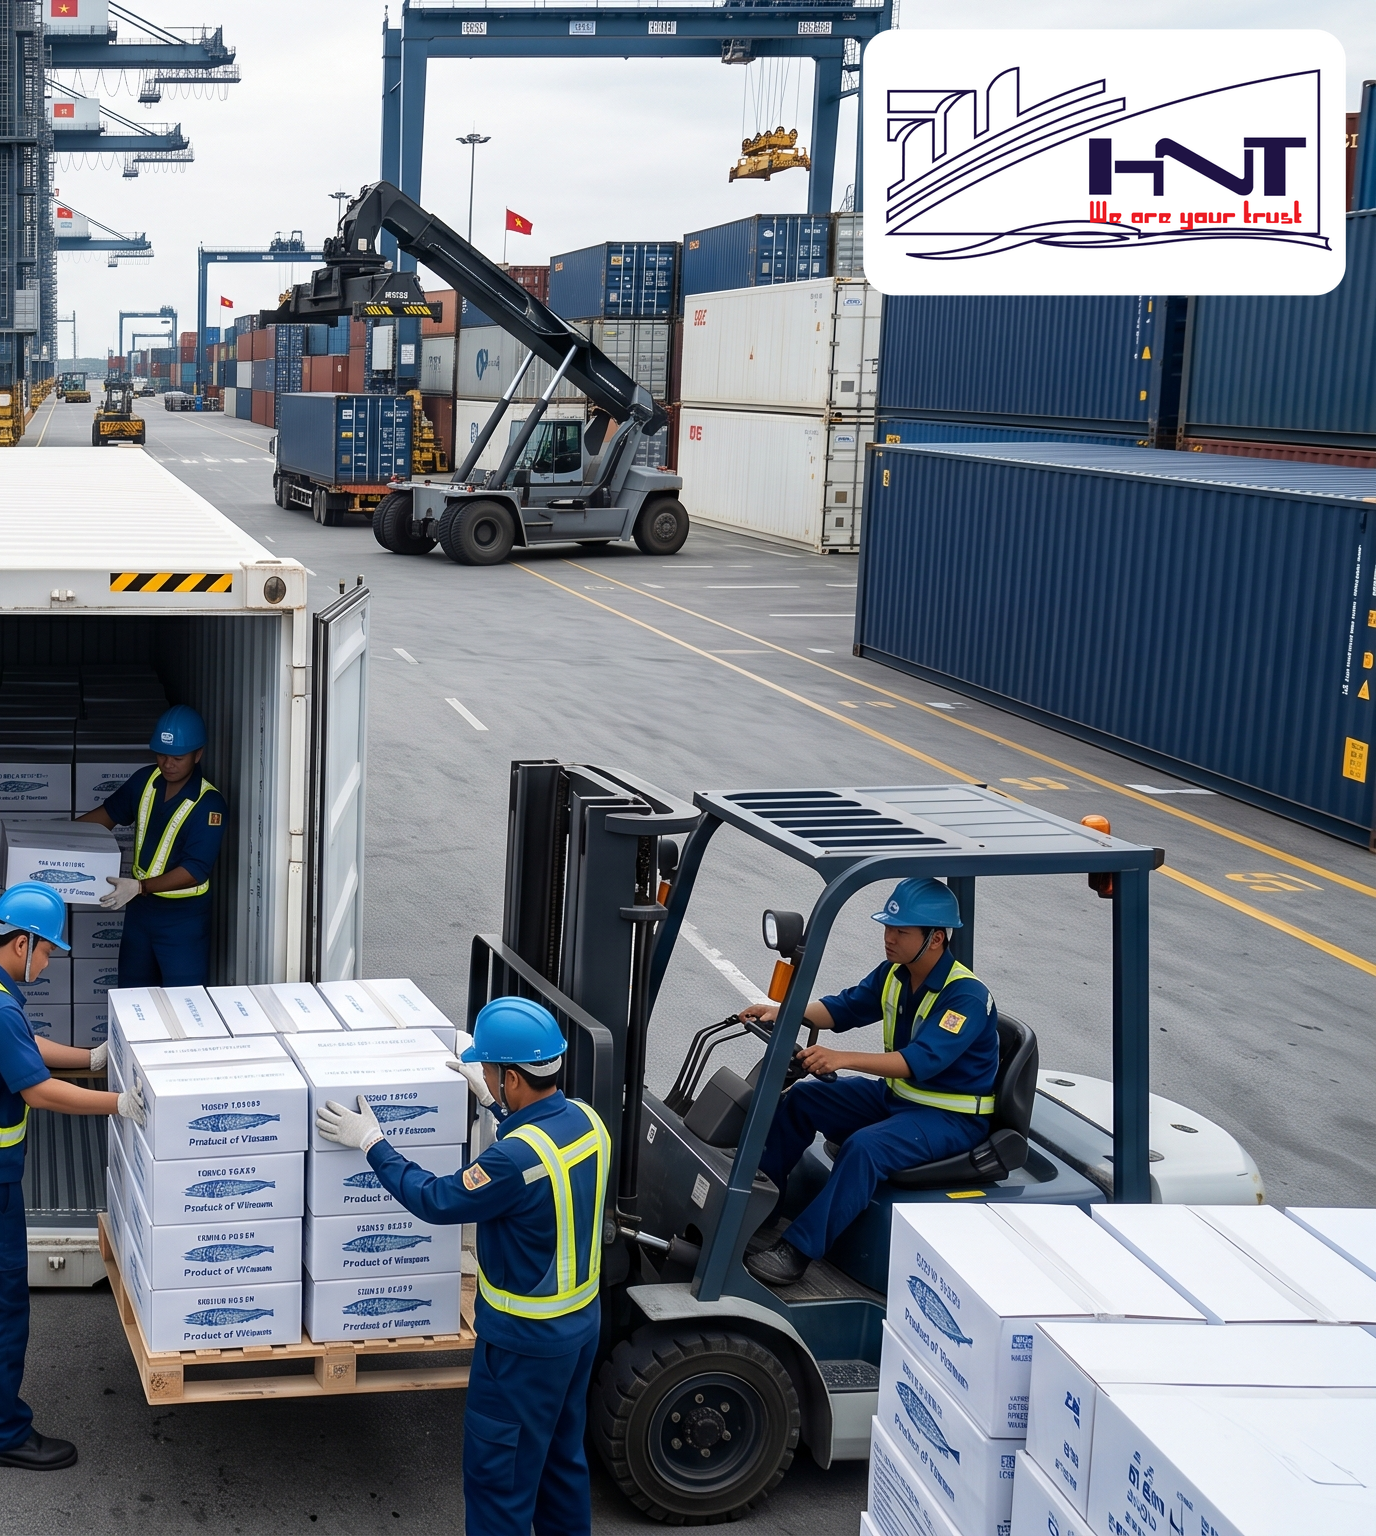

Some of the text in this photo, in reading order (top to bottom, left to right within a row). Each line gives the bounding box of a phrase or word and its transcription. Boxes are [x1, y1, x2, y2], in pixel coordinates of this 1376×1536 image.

[386, 1127, 397, 1136] of
[229, 1135, 240, 1144] of
[343, 1194, 382, 1203] Product
[224, 1202, 235, 1211] of
[343, 1258, 380, 1267] Product
[382, 1257, 393, 1266] of
[184, 1268, 222, 1277] Product
[224, 1266, 234, 1275] of
[382, 1320, 393, 1329] of
[183, 1331, 222, 1341] Product
[223, 1330, 234, 1339] of
